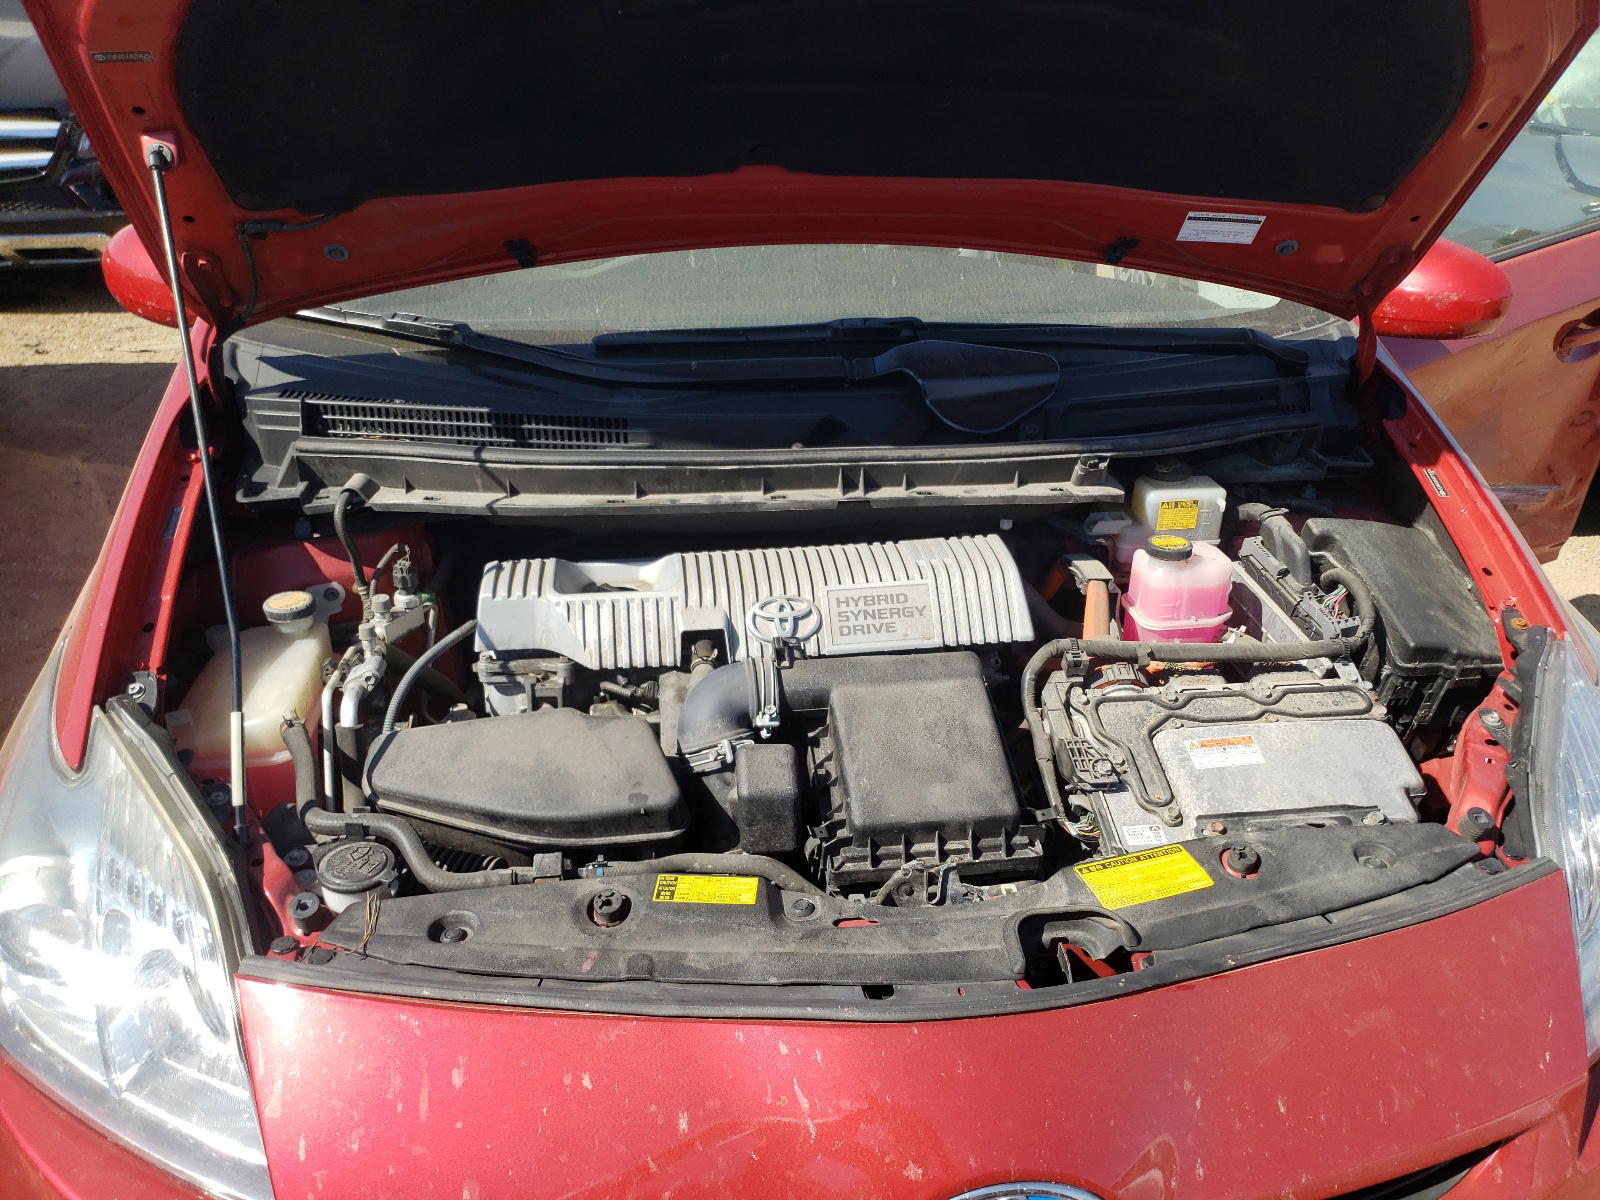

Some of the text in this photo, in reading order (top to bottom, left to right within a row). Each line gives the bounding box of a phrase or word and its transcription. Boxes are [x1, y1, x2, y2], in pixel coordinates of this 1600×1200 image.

[836, 593, 908, 608] HYBRID
[837, 605, 927, 623] SYNERGY
[839, 622, 896, 636] DRIVE
[1105, 857, 1138, 868] CAUTION
[1139, 846, 1181, 860] ATTENTION
